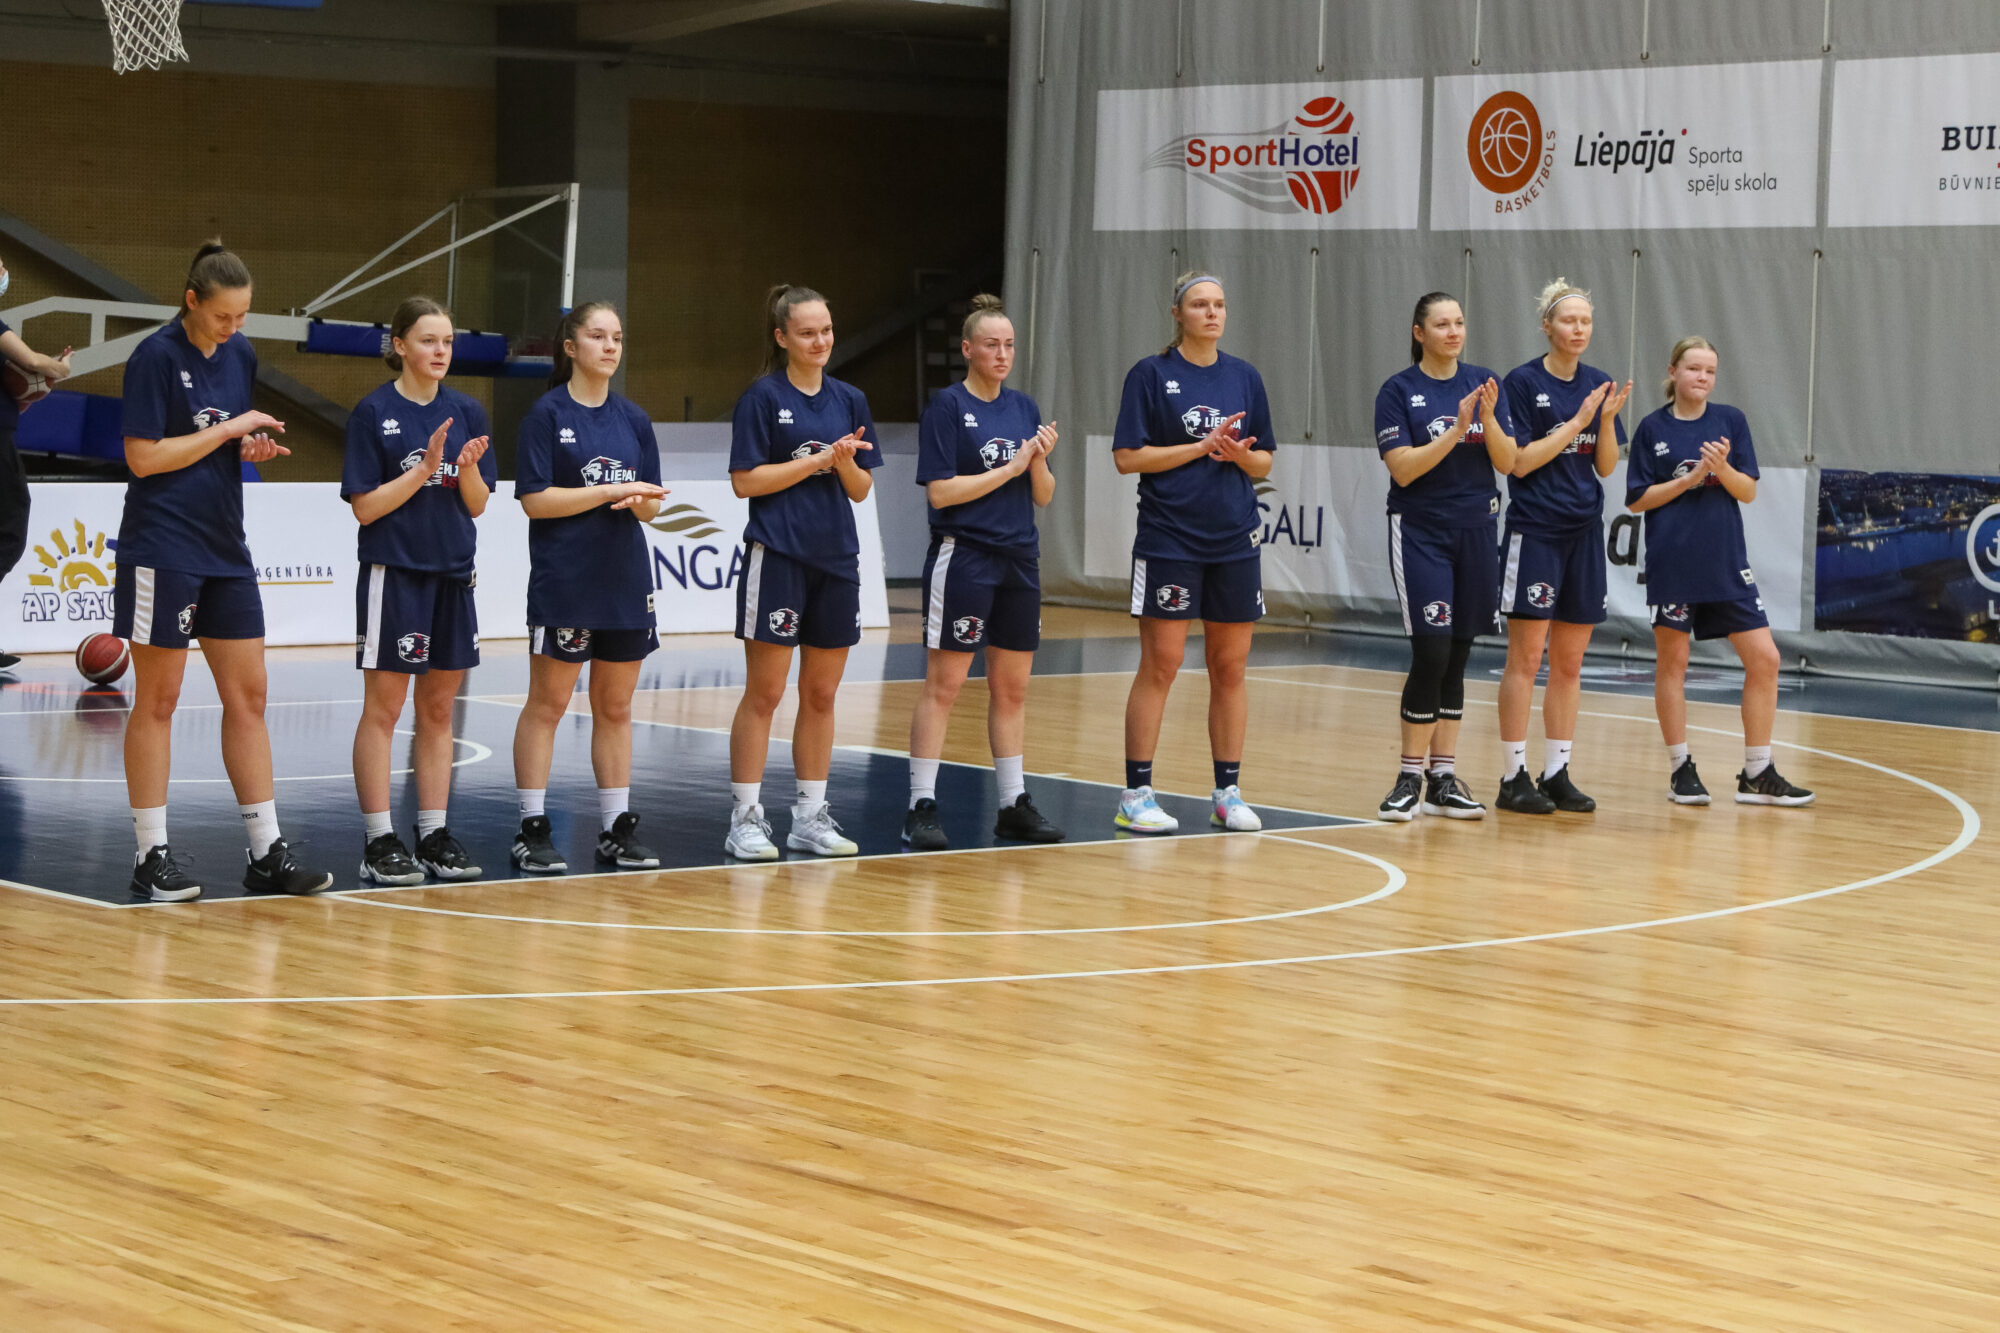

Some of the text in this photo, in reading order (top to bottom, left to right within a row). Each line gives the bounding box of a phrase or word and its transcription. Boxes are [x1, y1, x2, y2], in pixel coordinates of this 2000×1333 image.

[1941, 125, 2000, 151] BUI
[1186, 136, 1359, 174] SportHotel
[1574, 129, 1676, 174] Liepāja
[1688, 146, 1743, 168] Sporta
[1495, 130, 1556, 214] BASKETBOLS
[1687, 172, 1777, 196] spēļu skola
[255, 564, 334, 581] AĢENTŪRA
